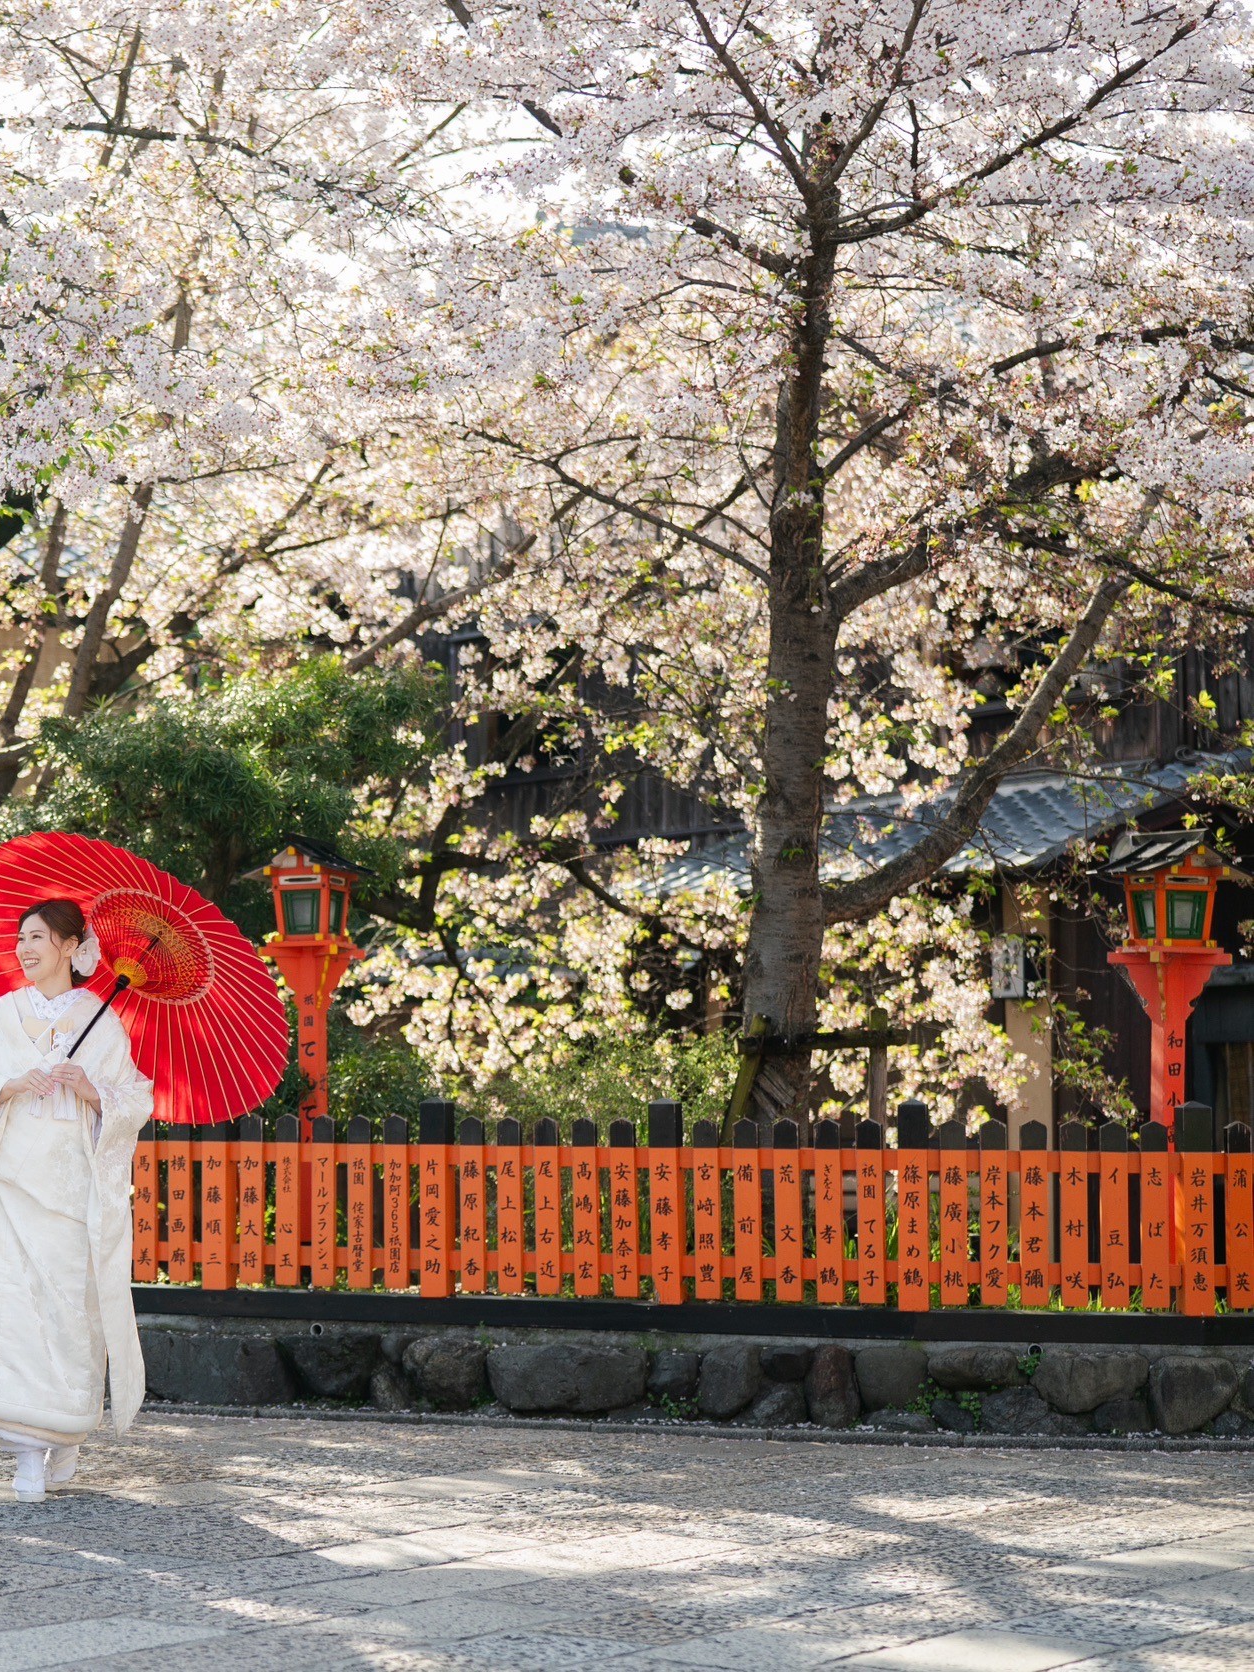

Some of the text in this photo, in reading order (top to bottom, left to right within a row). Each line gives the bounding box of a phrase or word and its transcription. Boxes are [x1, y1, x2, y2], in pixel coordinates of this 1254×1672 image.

[137, 1155, 152, 1266] 馬場弘美
[170, 1155, 186, 1266] 横田画廊
[206, 1155, 222, 1266] 加藤順三
[243, 1156, 259, 1268] 加藤大将
[282, 1156, 292, 1193] 株式会社
[317, 1157, 329, 1271] マールブランシュ
[352, 1157, 365, 1186] 祇園
[389, 1158, 402, 1274] 加加阿365祇園店
[425, 1159, 441, 1275] 片岡愛之助
[462, 1159, 480, 1276] 藤原紀香
[500, 1160, 517, 1278] 尾上松也
[538, 1160, 557, 1279] 尾上右近
[614, 1162, 633, 1281] 安藤加奈子
[654, 1162, 674, 1282] 安藤孝子
[736, 1163, 756, 1284] 備前屋
[819, 1164, 839, 1287] ぎをん 孝鶴
[861, 1164, 879, 1287] 祇園 てる子
[902, 1164, 924, 1288] 篠原まめ鶴
[944, 1165, 964, 1288] 藤廣小桃
[985, 1165, 1004, 1289] 岸本フク愛
[1024, 1165, 1045, 1289] 藤本君彌
[1065, 1166, 1086, 1290] 木村咲
[1147, 1167, 1165, 1290] 志ばた
[1190, 1167, 1208, 1292] 岩井万須恵
[1232, 1168, 1251, 1292] 蒲公英
